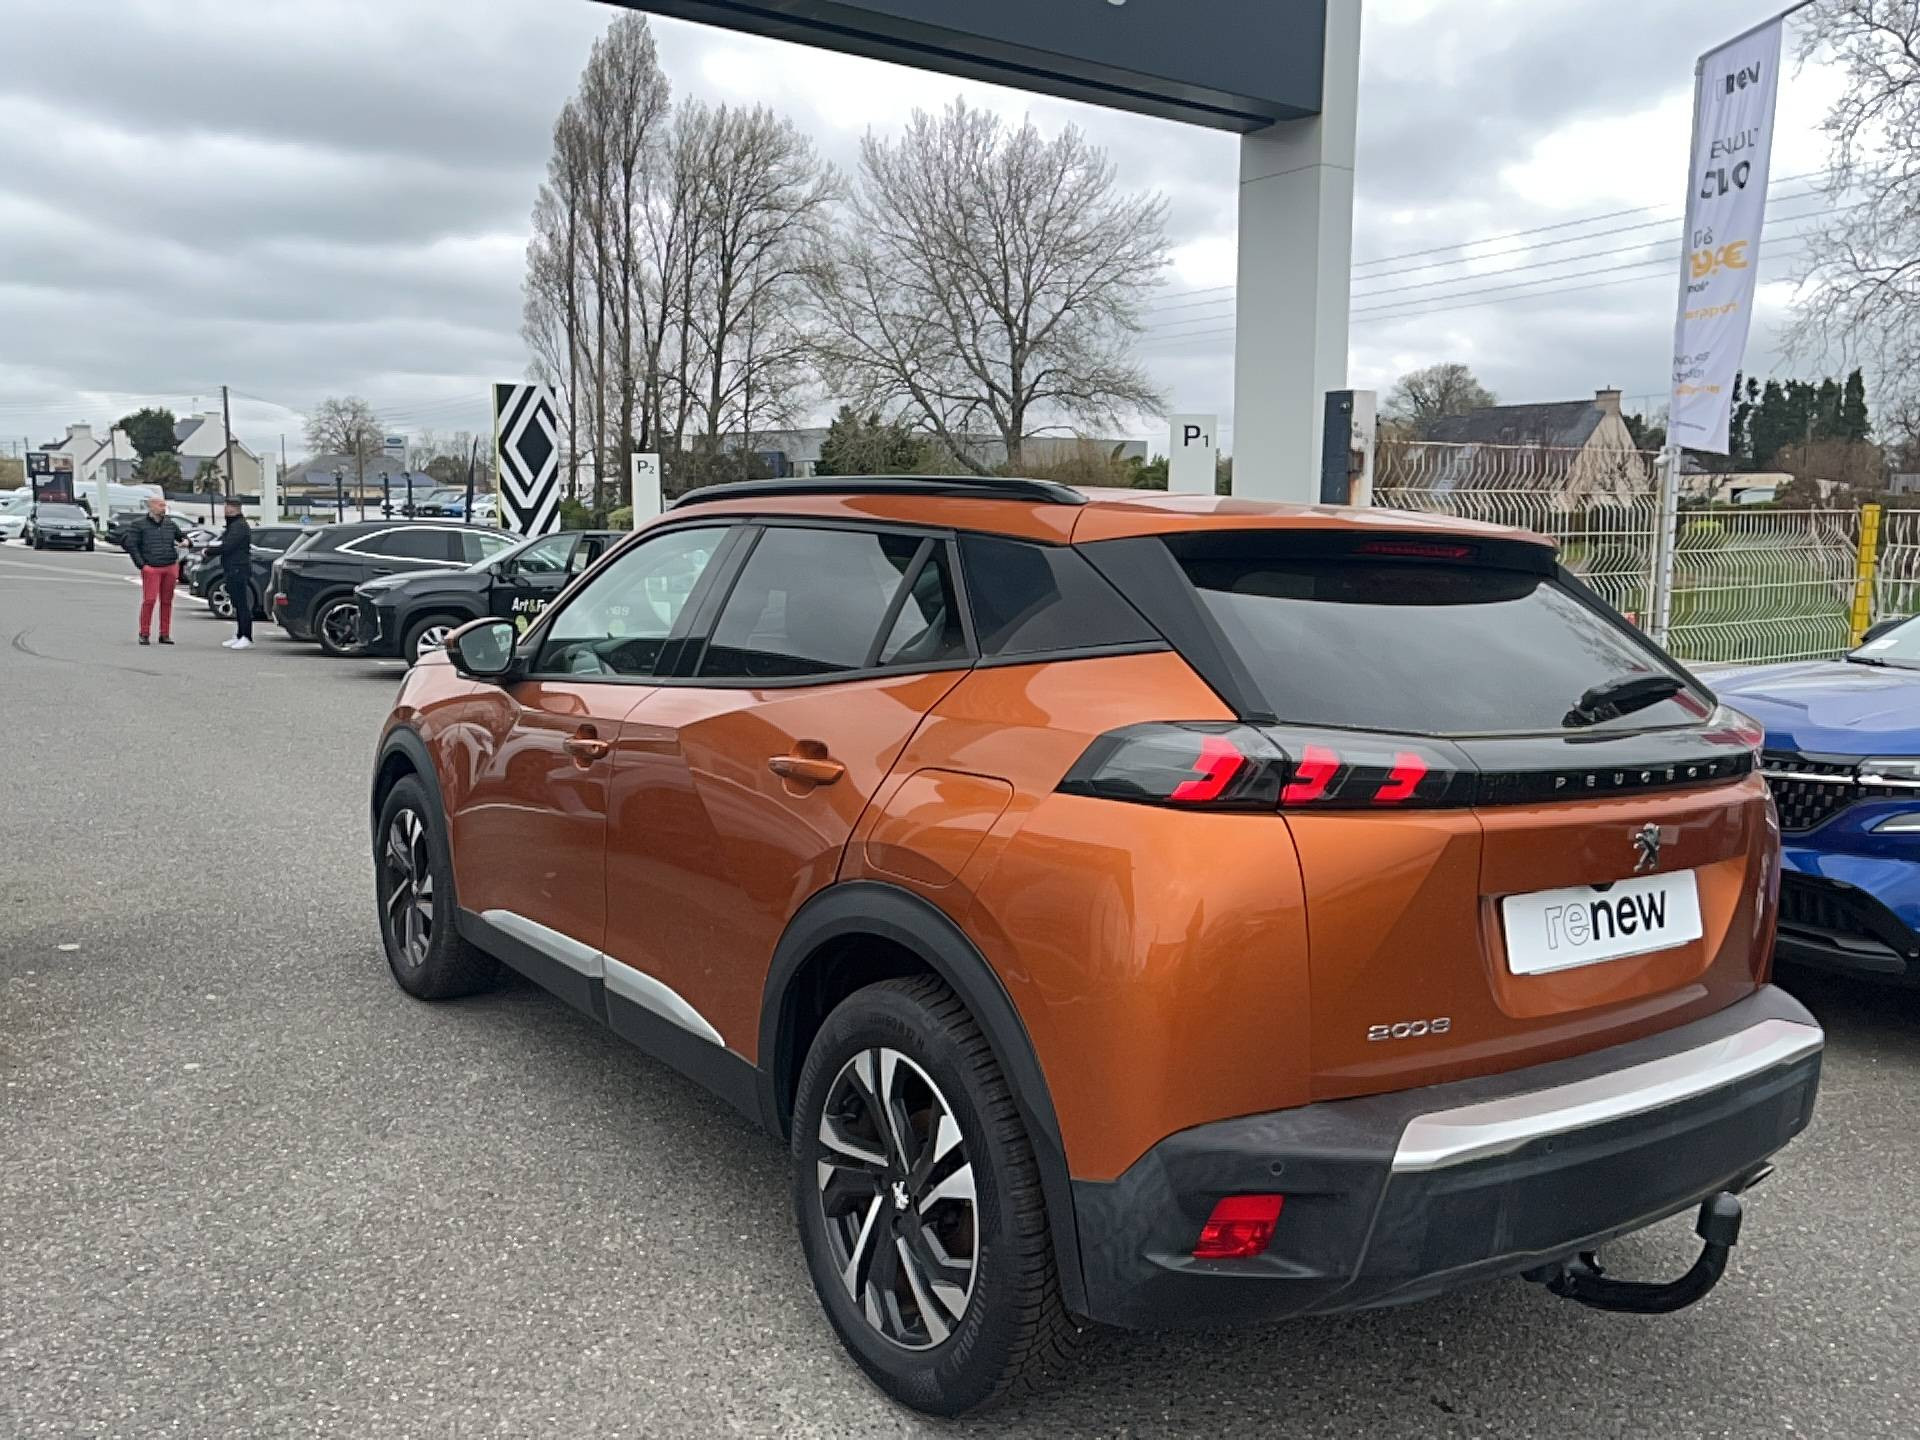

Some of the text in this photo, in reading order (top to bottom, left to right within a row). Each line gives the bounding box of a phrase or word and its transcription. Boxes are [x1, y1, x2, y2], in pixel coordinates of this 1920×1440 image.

[1183, 425, 1209, 448] P1
[637, 459, 655, 475] P2
[1555, 763, 1718, 789] PEUGEOT
[1544, 890, 1667, 950] renew
[1367, 1017, 1452, 1041] 2008
